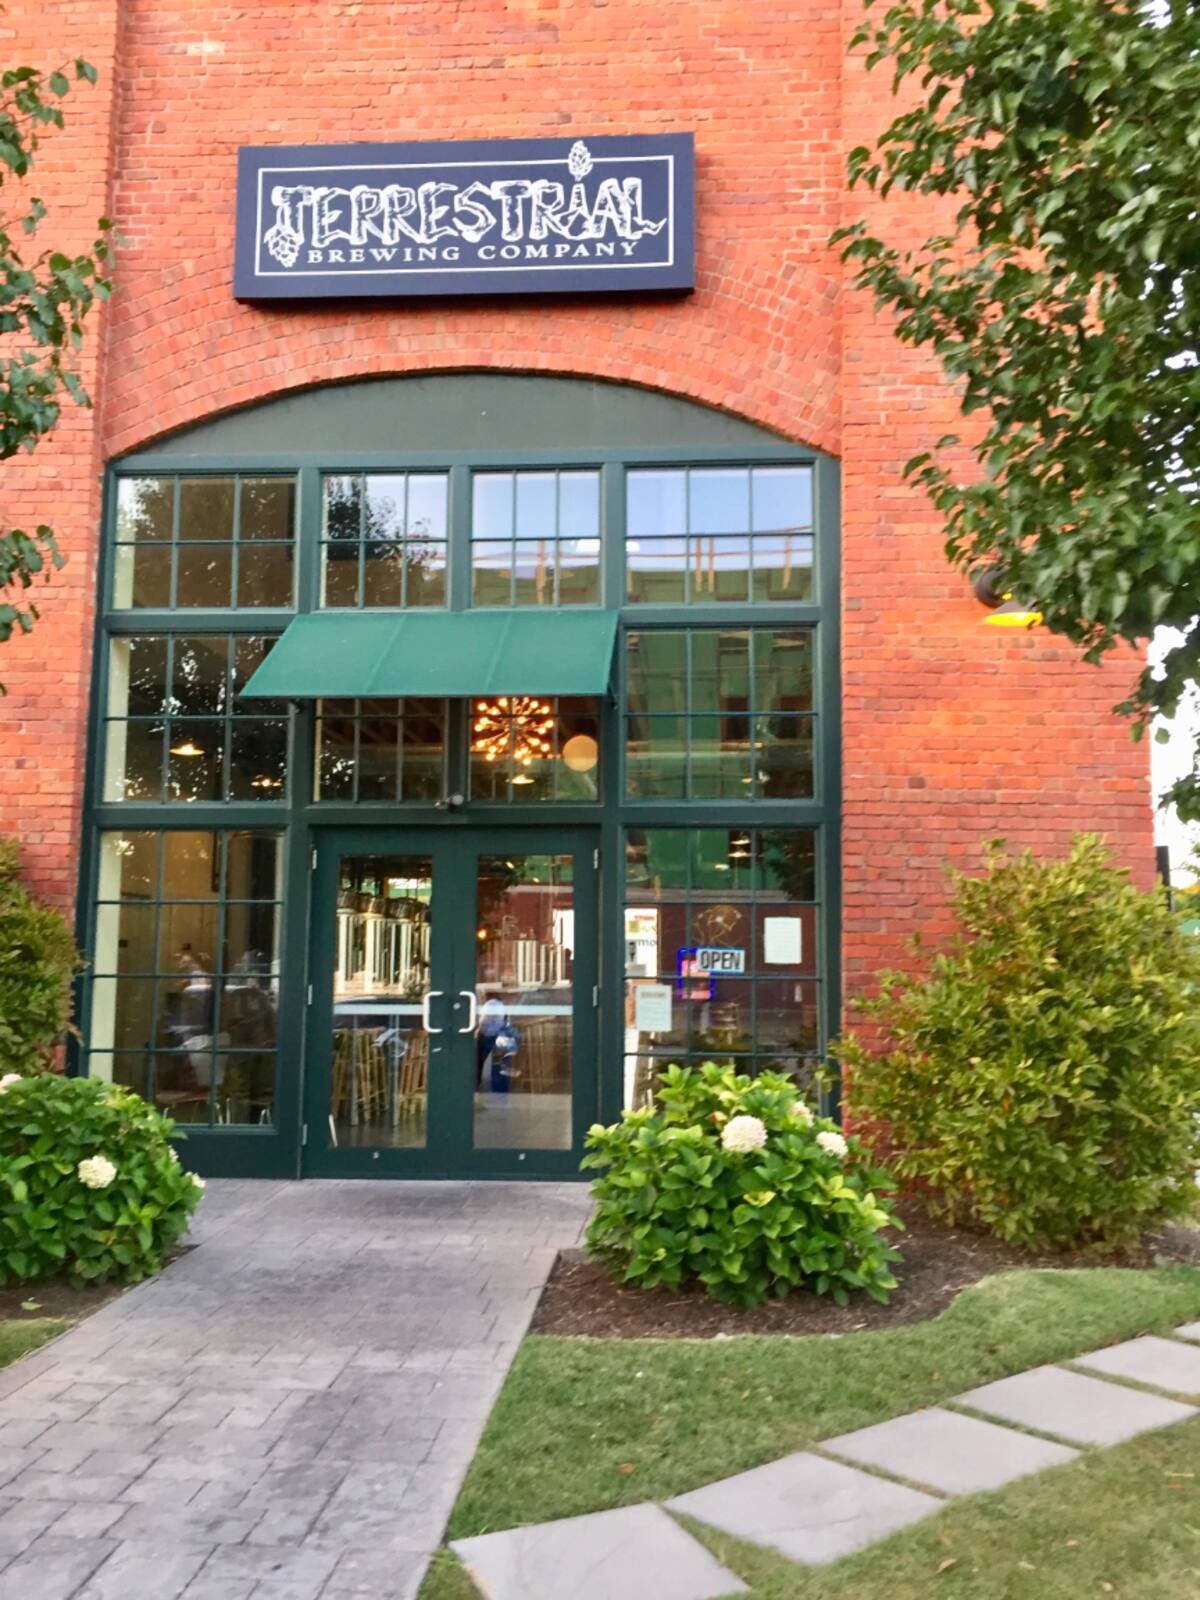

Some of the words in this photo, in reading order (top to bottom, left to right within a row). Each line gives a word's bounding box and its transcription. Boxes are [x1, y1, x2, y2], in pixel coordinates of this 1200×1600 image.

[271, 177, 667, 246] TERRESTRIAL
[307, 243, 461, 265] BREWING
[477, 241, 640, 260] COMPANY
[700, 950, 741, 970] OPEN
